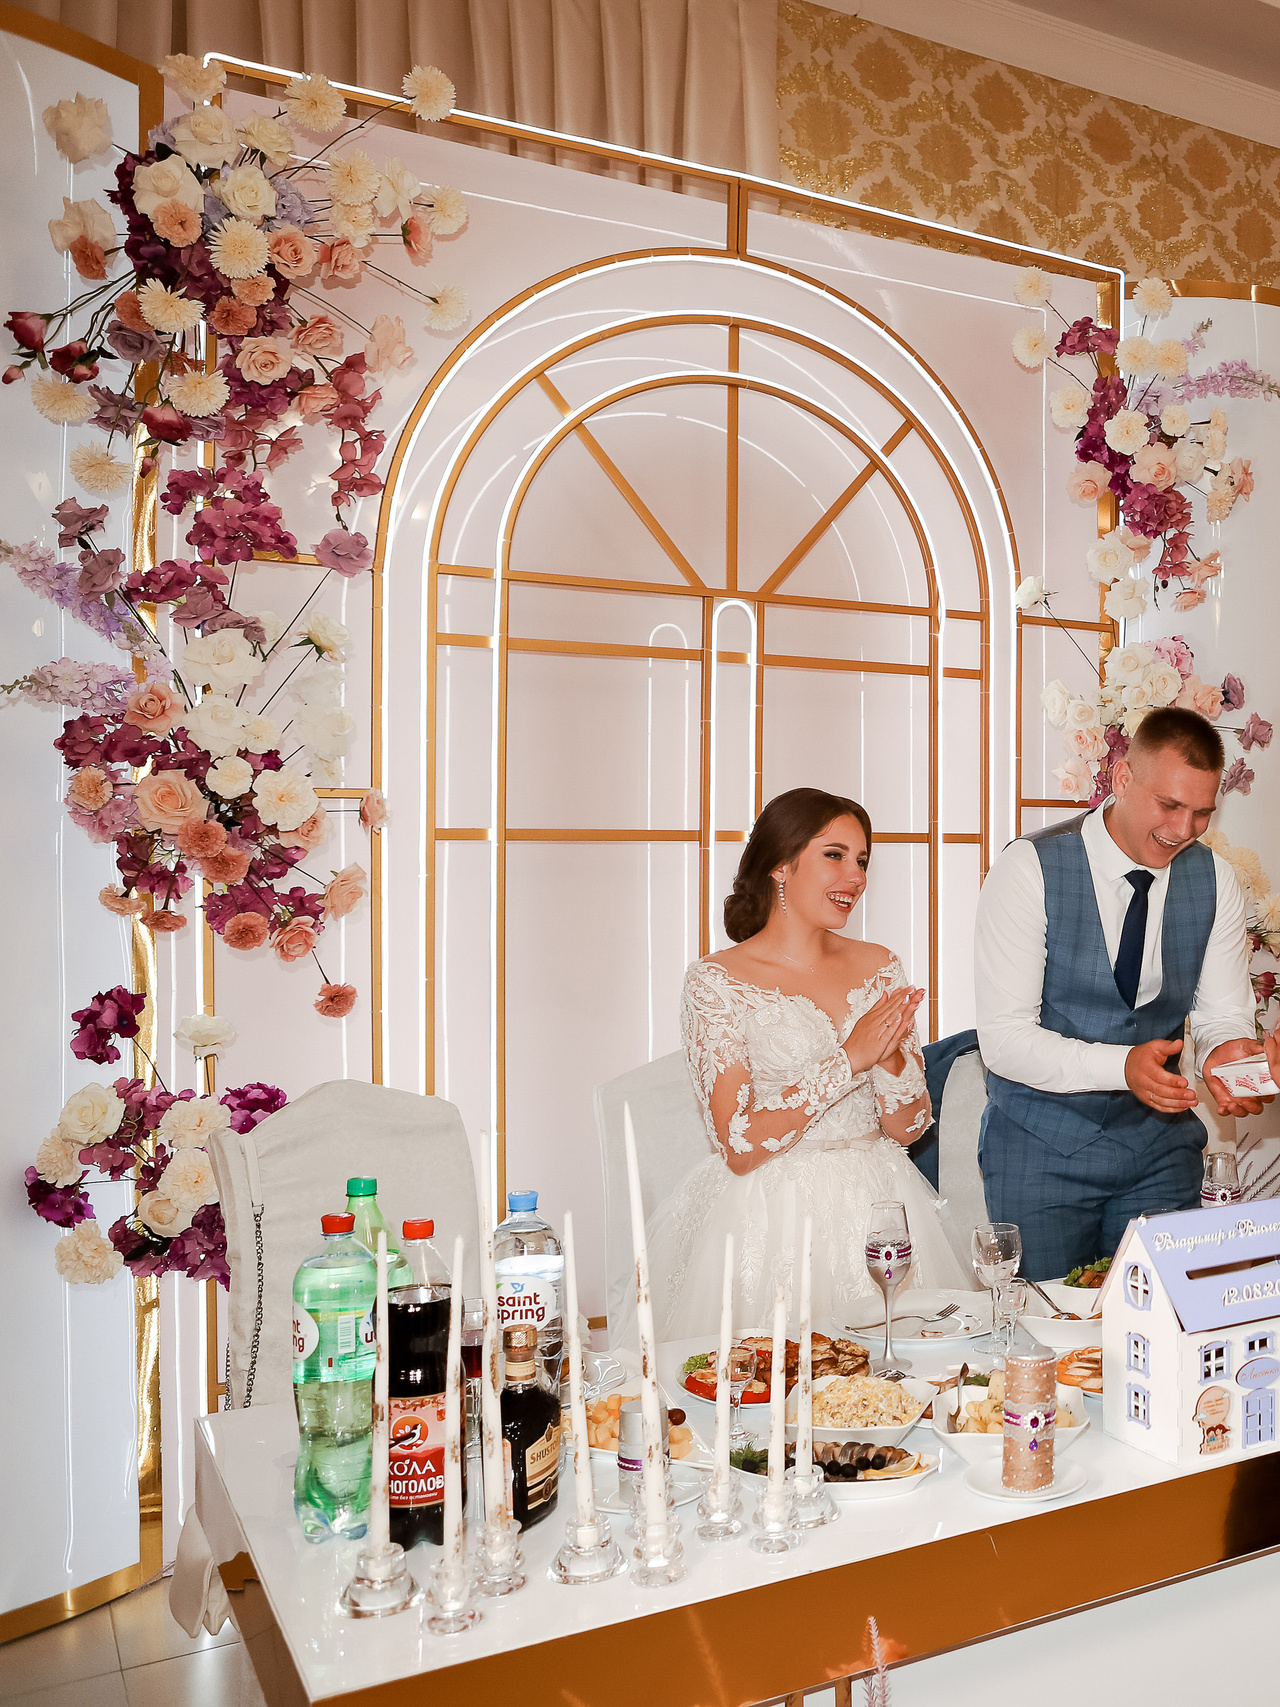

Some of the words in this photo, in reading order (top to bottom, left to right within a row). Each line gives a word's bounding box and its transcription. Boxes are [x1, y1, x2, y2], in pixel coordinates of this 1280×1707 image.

[1152, 1229, 1227, 1253] Владимир
[1228, 1229, 1237, 1239] и
[497, 1292, 540, 1307] saint
[529, 1438, 558, 1465] SHUSTO
[389, 1475, 444, 1494] НОГОЛОВ
